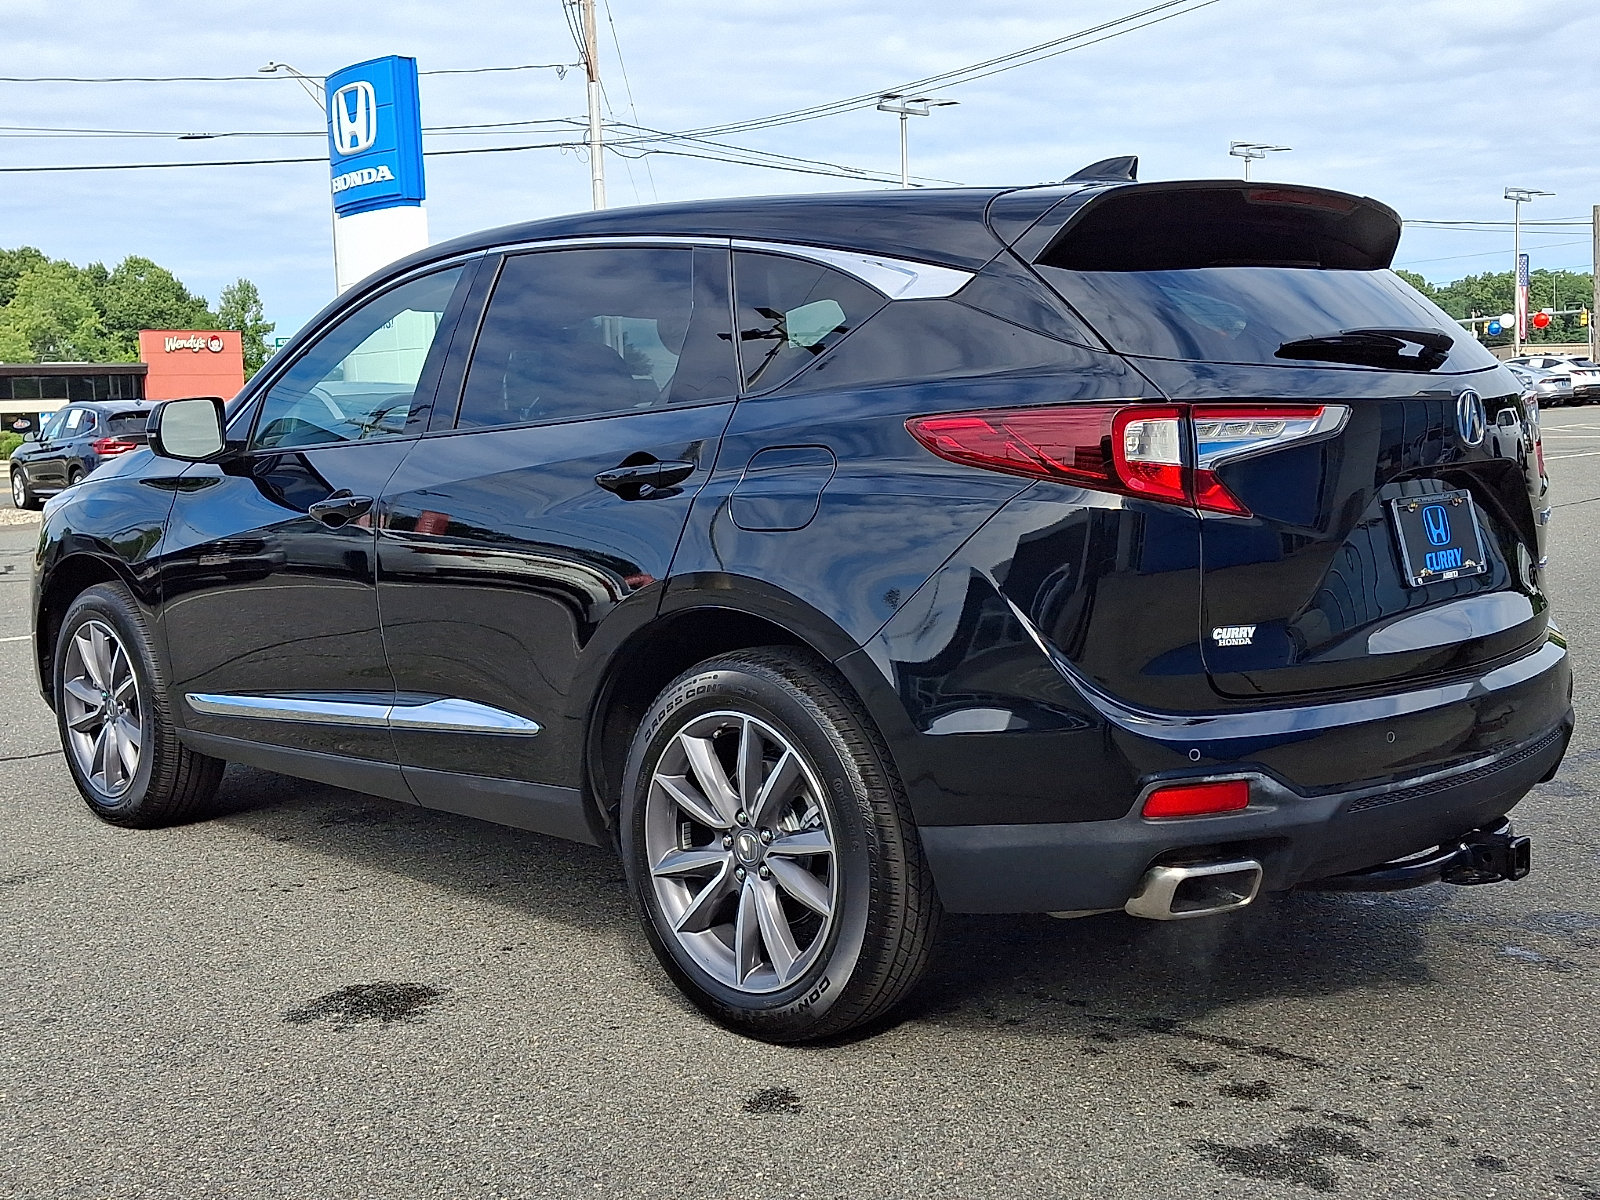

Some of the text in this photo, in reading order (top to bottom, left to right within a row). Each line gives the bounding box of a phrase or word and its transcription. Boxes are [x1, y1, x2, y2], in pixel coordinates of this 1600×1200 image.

[331, 165, 395, 193] HONDA
[165, 335, 205, 352] Wendy's
[1425, 547, 1462, 571] CURRY
[1212, 626, 1256, 640] CURRY
[1218, 638, 1252, 646] HONDA
